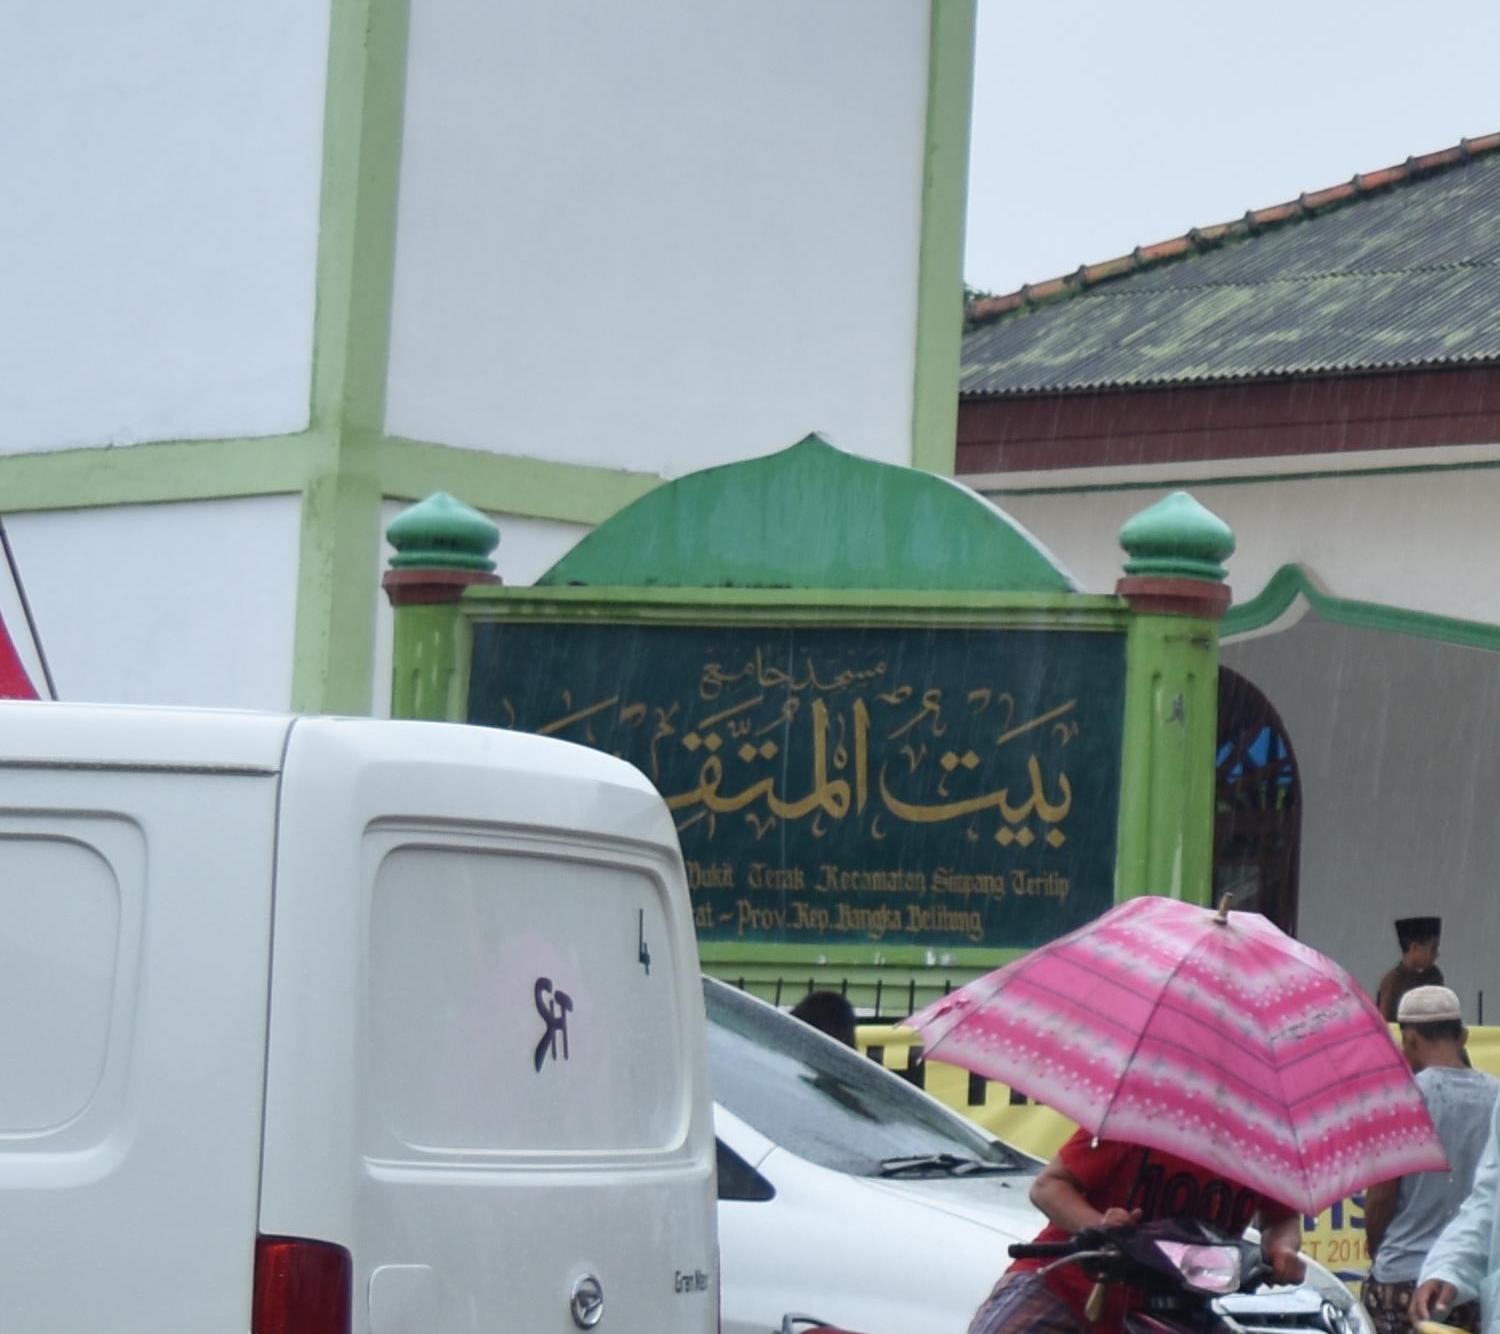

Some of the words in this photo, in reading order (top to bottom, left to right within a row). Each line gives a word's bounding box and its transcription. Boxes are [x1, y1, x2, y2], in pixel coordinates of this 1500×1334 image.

[815, 865, 926, 894] Kecamatan
[931, 867, 1006, 901] Simpang
[905, 904, 985, 942] Belitung
